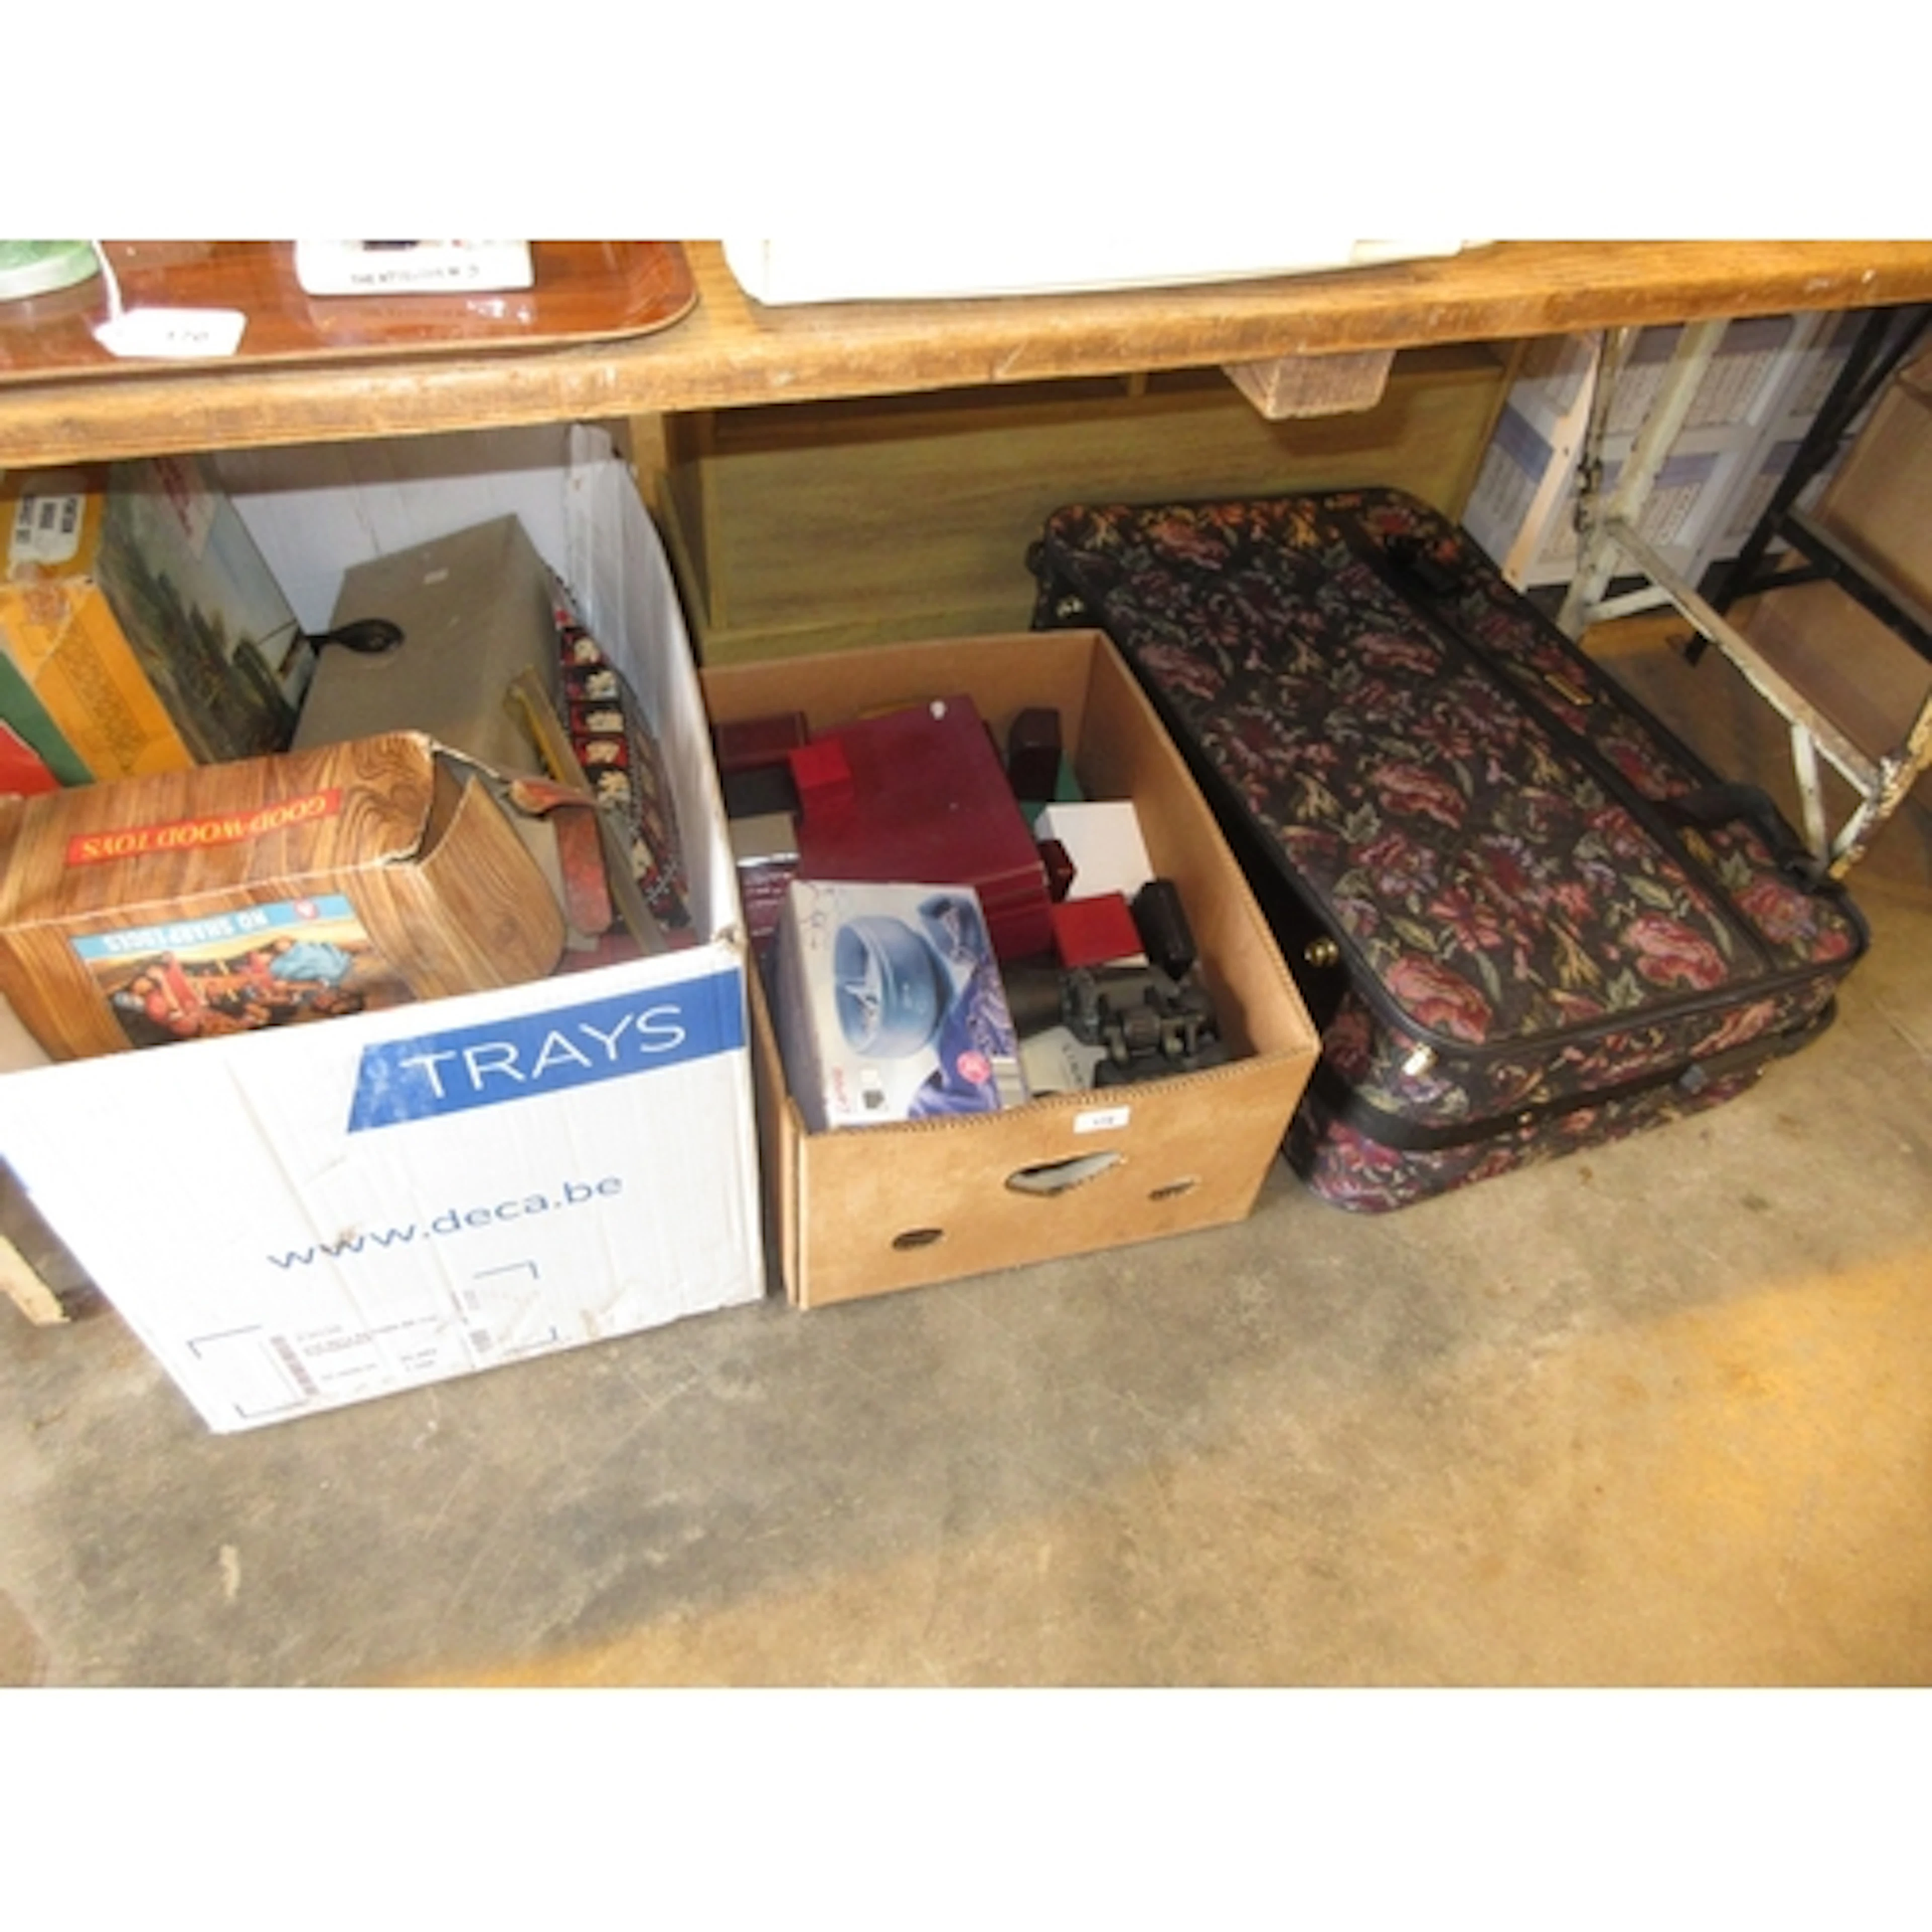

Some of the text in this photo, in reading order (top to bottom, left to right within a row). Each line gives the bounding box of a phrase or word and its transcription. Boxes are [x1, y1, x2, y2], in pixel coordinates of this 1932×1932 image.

[83, 834, 149, 857] TOYS
[234, 908, 269, 928] NO
[399, 1005, 687, 1100] TRAYS
[267, 1173, 624, 1270] www.deca.be
